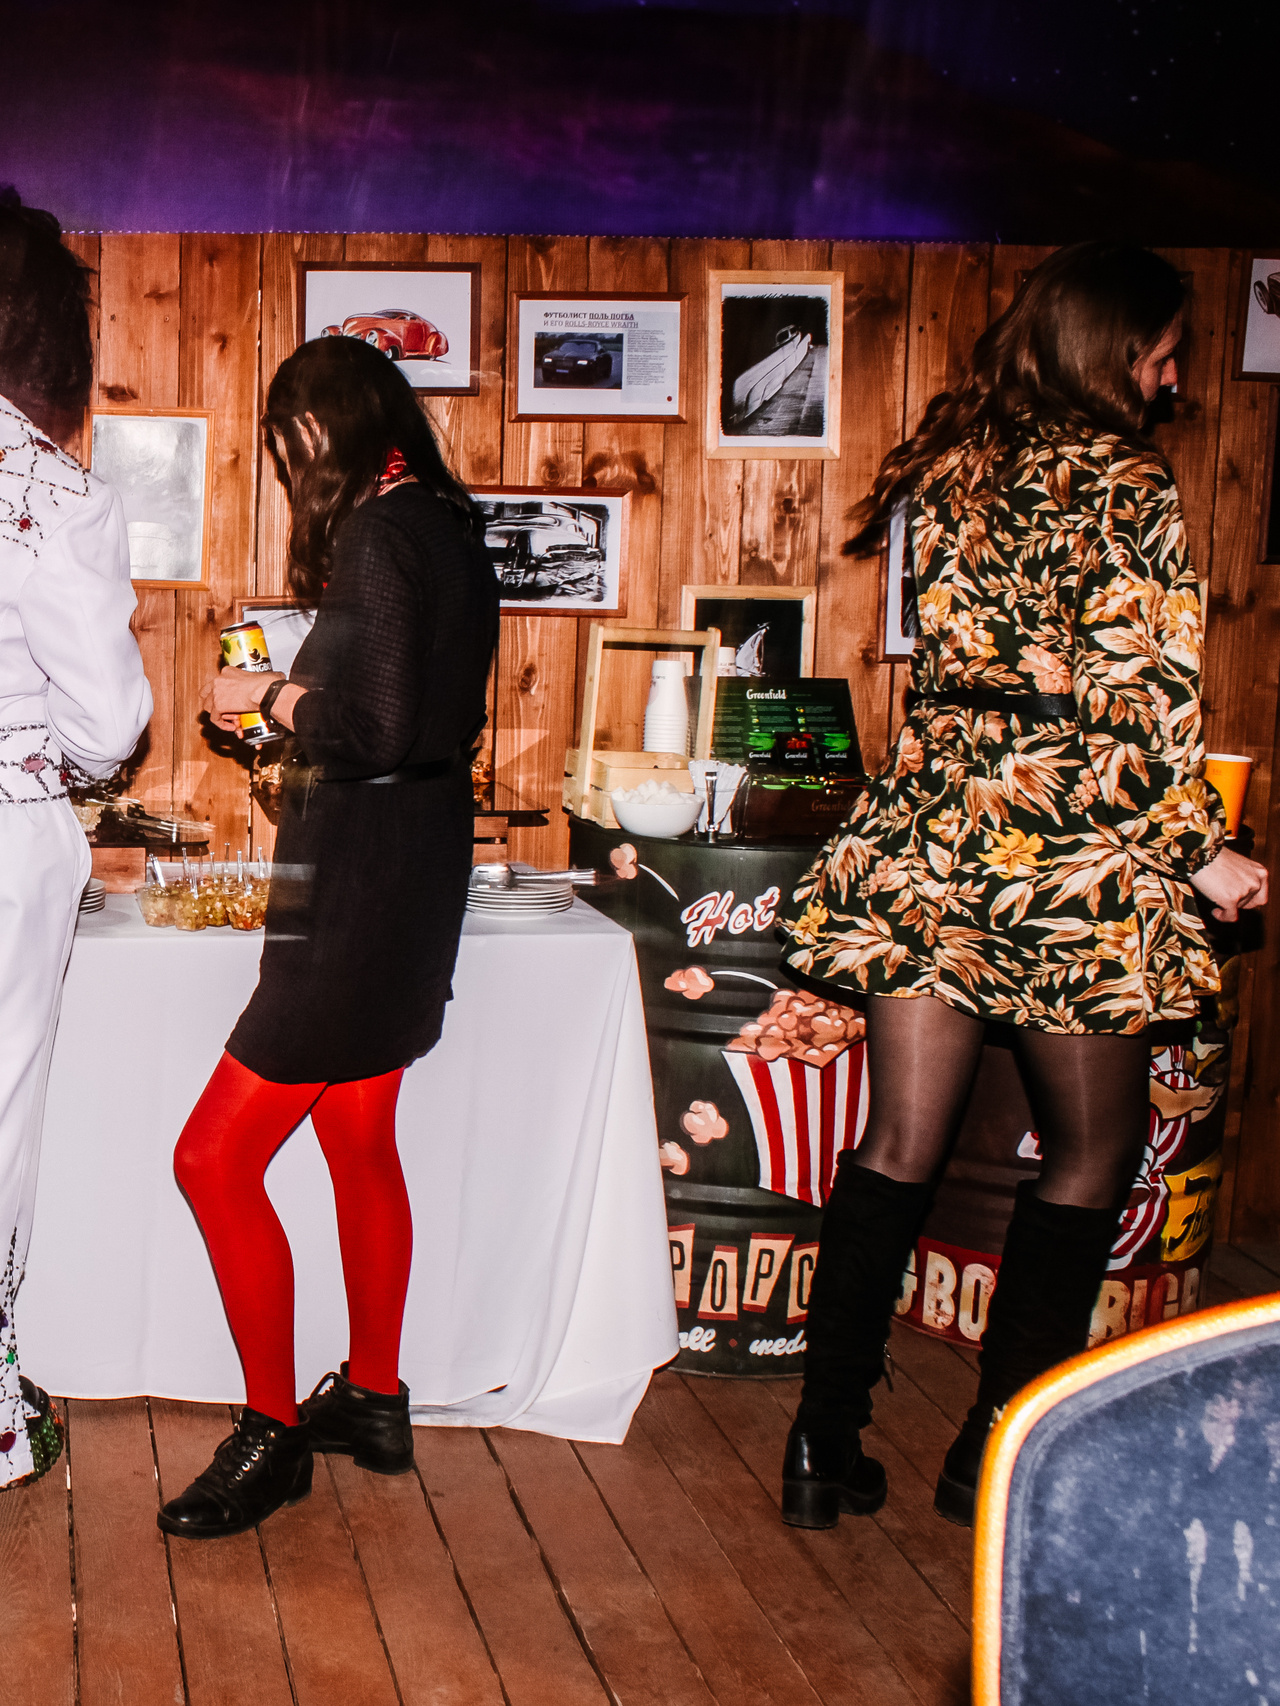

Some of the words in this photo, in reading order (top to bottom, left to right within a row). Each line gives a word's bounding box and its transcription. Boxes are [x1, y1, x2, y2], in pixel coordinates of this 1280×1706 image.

[589, 312, 609, 320] ПОЛЬ
[746, 688, 787, 700] Greenfield
[680, 886, 780, 947] Hot
[668, 1236, 816, 1314] POPC
